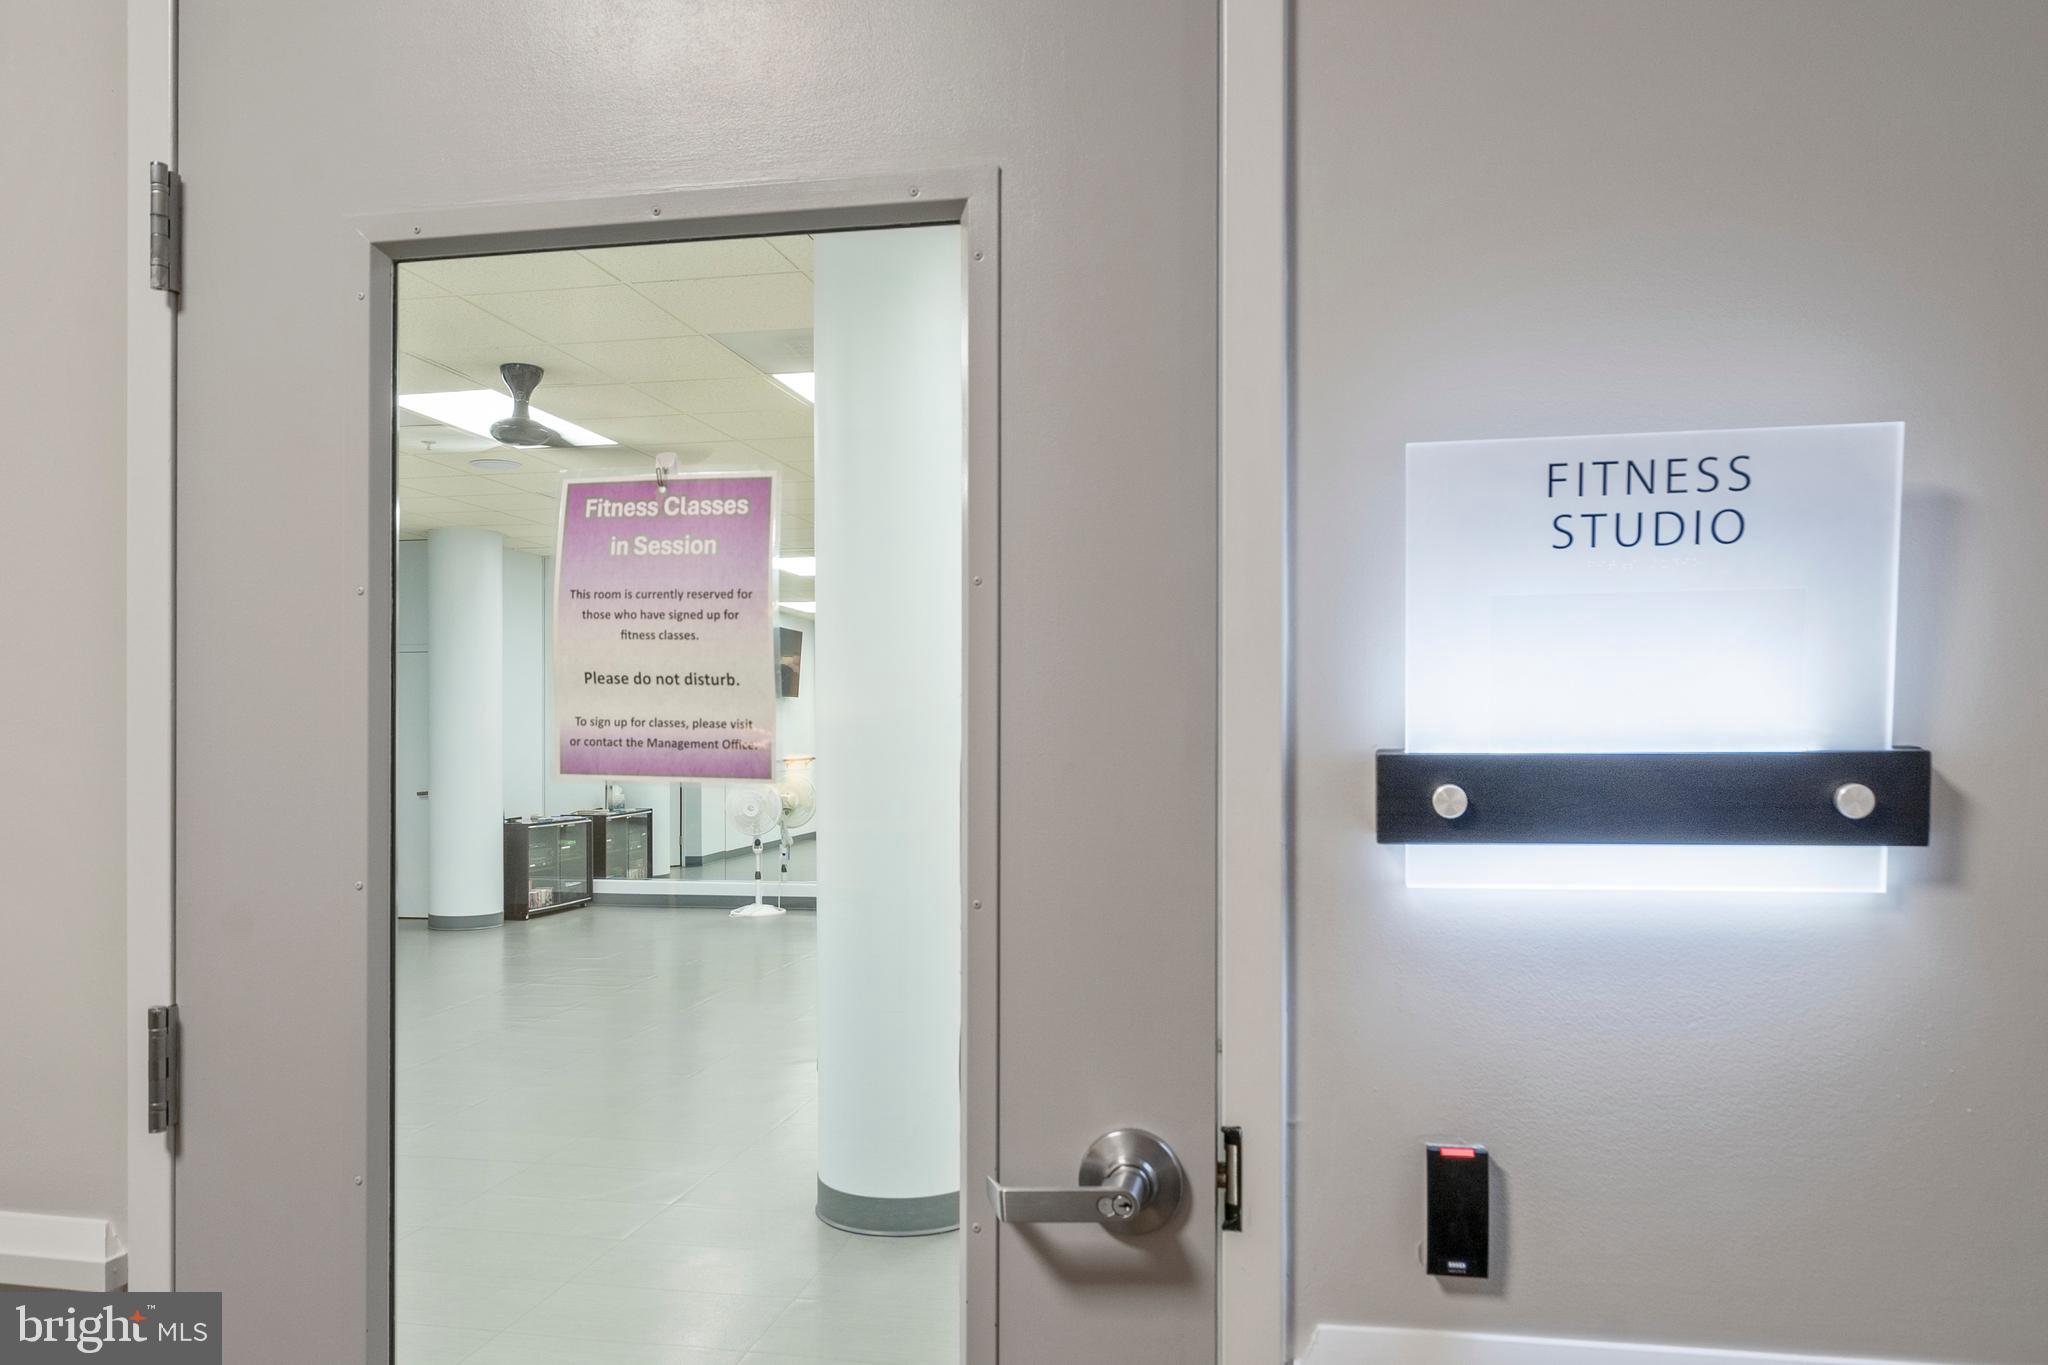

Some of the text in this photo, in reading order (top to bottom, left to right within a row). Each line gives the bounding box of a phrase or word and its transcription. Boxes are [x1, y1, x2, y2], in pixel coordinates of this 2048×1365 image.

[1547, 455, 1752, 498] FITNESS
[585, 496, 749, 518] Fitness Classes
[1552, 508, 1746, 550] STUDIO
[610, 536, 717, 555] in Session
[570, 589, 753, 601] This room is currently reserved for
[582, 609, 740, 623] those who have signed up for
[621, 630, 699, 641] fitness classes.
[584, 672, 740, 686] Please do not disturb.
[575, 717, 752, 731] To sign up for classes, please visit
[570, 738, 580, 747] or
[584, 737, 623, 747] contact
[626, 737, 643, 747] the
[647, 738, 719, 751] Management
